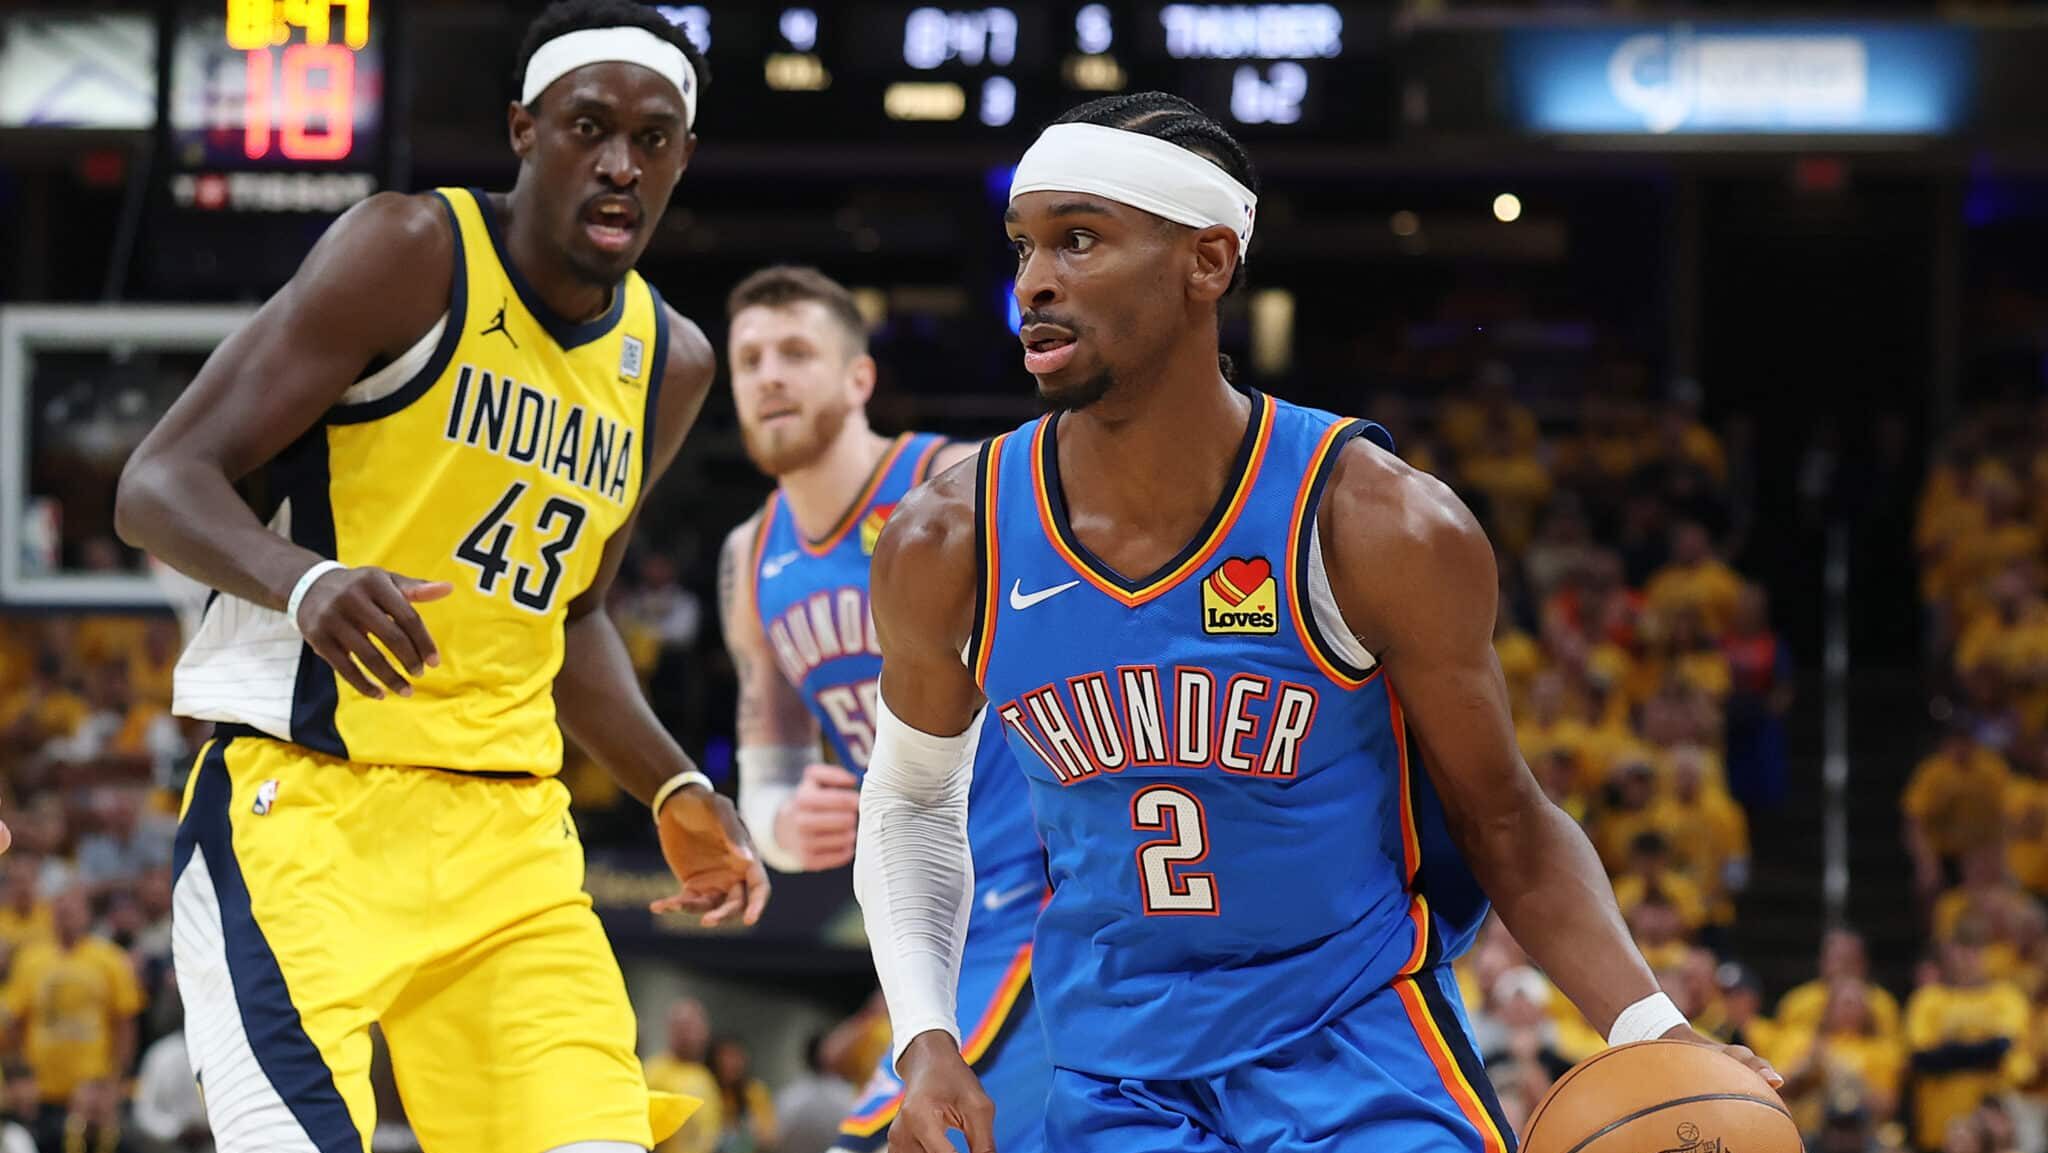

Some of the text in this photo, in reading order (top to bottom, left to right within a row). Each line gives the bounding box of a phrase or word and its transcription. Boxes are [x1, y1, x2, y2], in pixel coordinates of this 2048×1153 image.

[1160, 3, 1343, 59] THUNDER
[244, 43, 356, 160] 18
[1231, 61, 1308, 125] 62
[445, 365, 634, 505] INDIANA
[453, 481, 588, 615] 43
[997, 664, 1320, 787] THUNDER
[1130, 784, 1220, 917] 2
